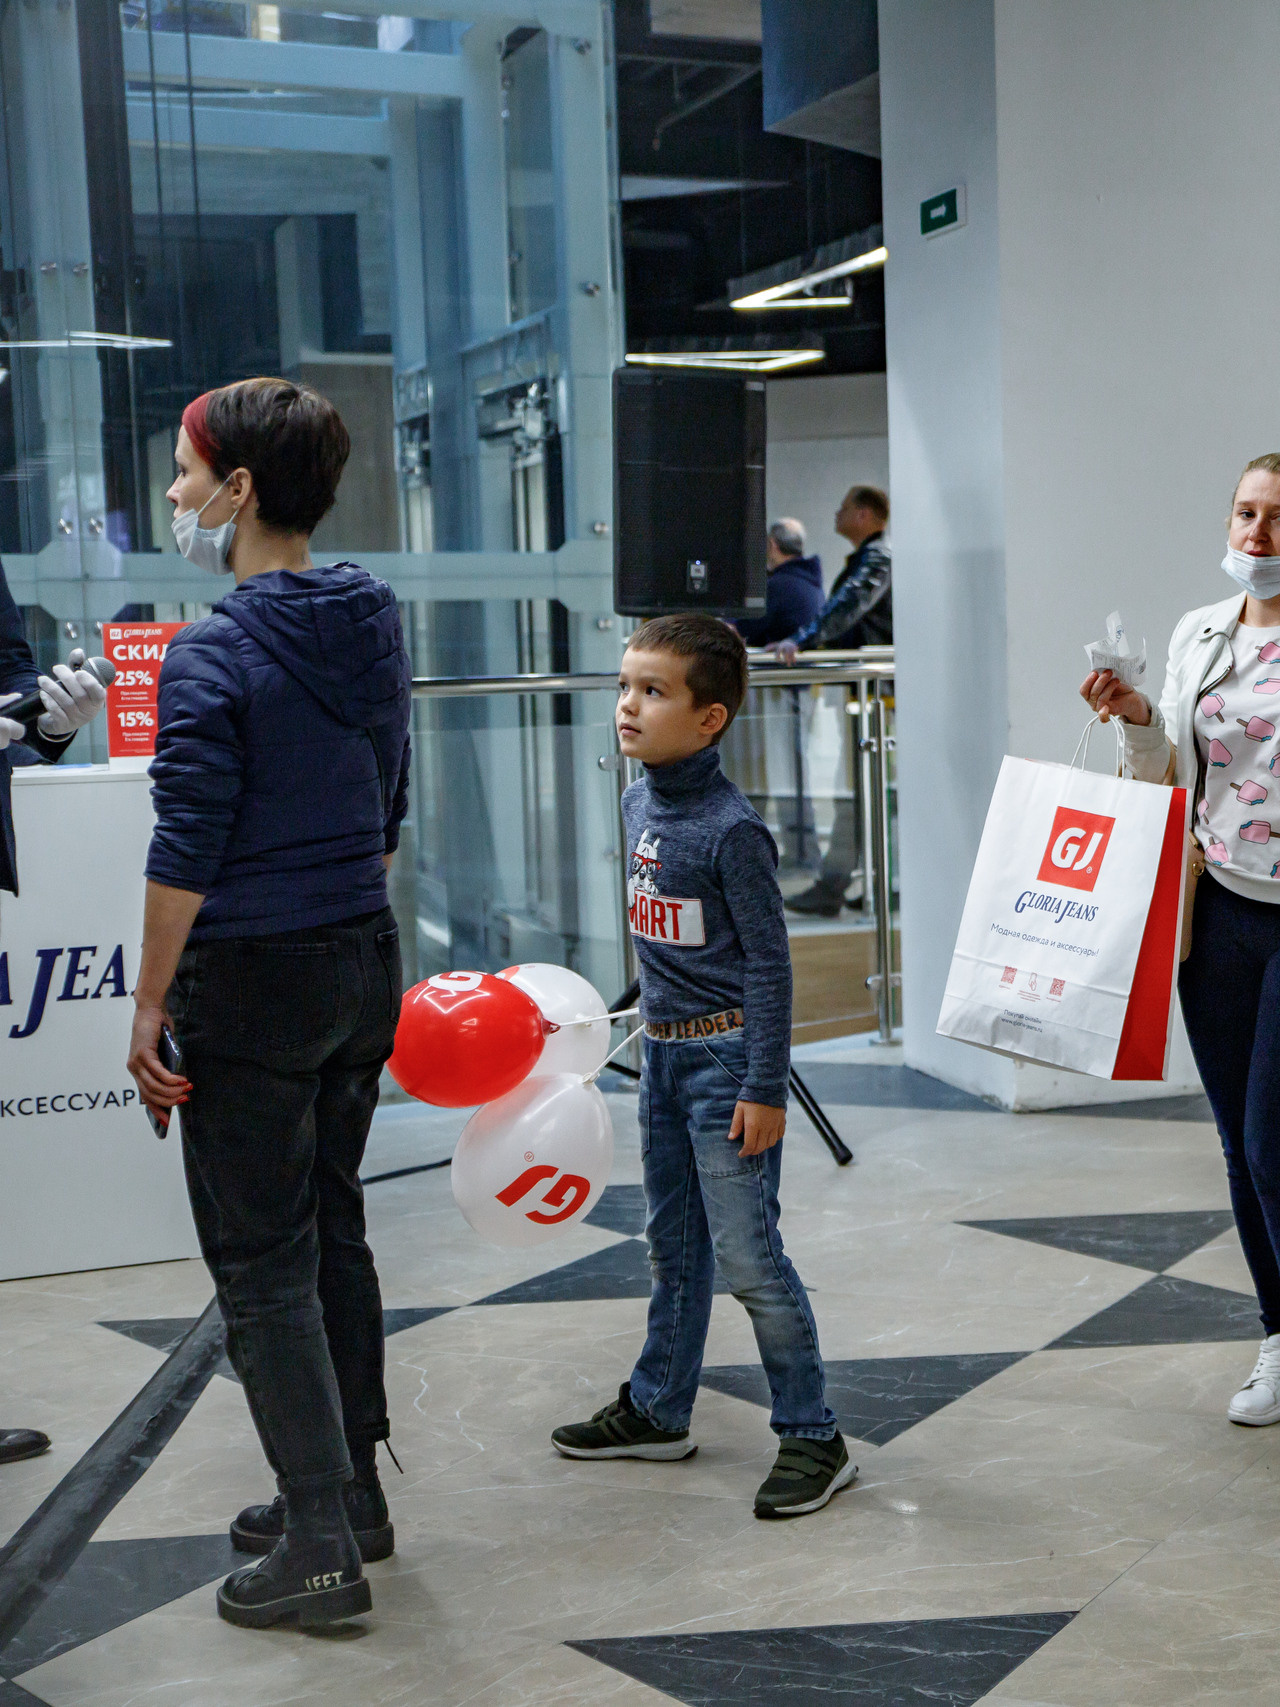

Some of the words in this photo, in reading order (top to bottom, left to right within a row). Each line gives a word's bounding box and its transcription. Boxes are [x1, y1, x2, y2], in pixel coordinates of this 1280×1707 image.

[115, 670, 153, 687] 25%
[117, 711, 155, 727] 15%
[1050, 827, 1104, 872] GJ
[1014, 890, 1063, 914] GLORIA
[1054, 900, 1099, 924] JEANS
[990, 922, 1021, 939] Модная
[1021, 933, 1050, 947] одежда
[1050, 940, 1057, 948] и
[8, 943, 144, 1039] JEA
[675, 1010, 738, 1040] LEADER
[0, 1088, 146, 1118] КСЕССУАР
